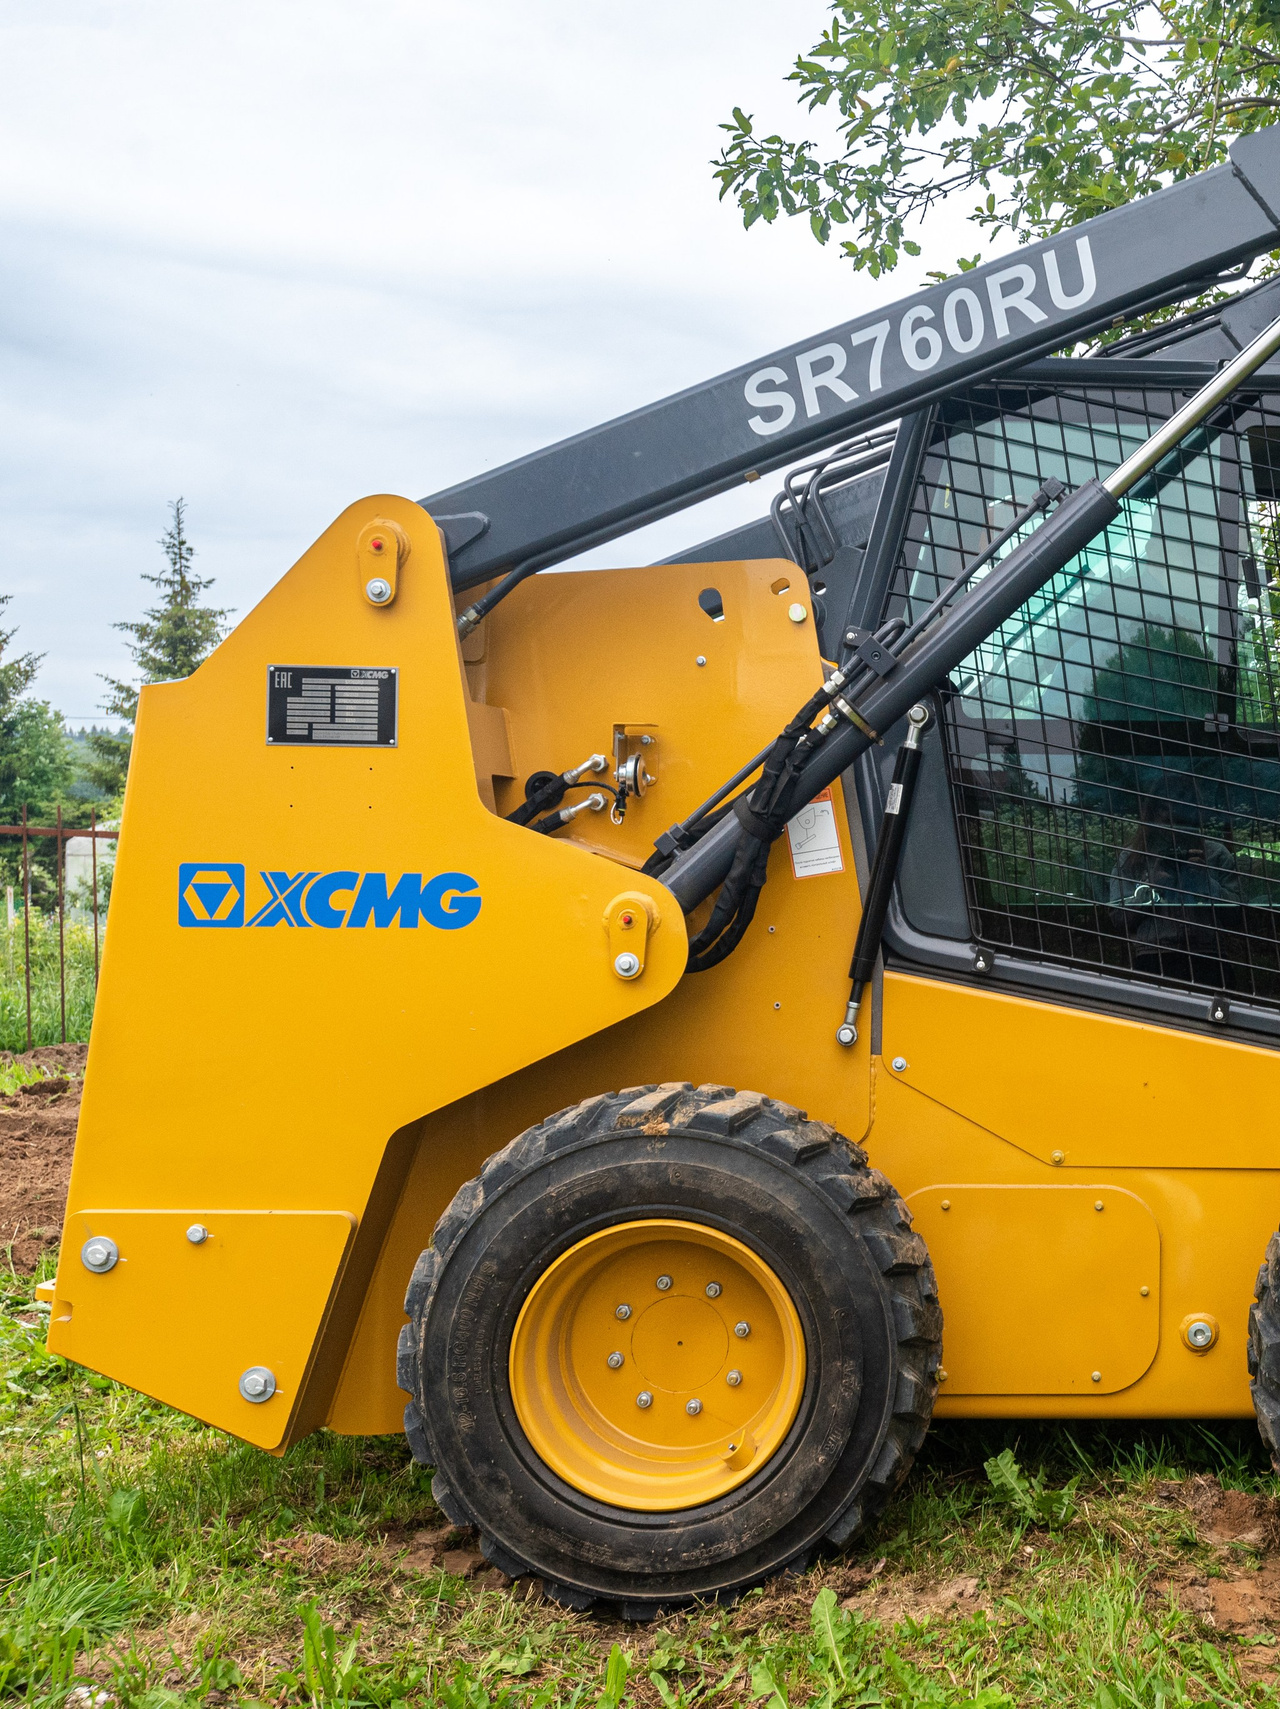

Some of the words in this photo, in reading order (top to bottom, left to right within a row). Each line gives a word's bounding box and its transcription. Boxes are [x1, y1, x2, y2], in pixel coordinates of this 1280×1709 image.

[743, 235, 1097, 436] SR760RU
[360, 670, 389, 679] XCMG
[244, 871, 482, 930] XCMG
[452, 1308, 475, 1368] RG400
